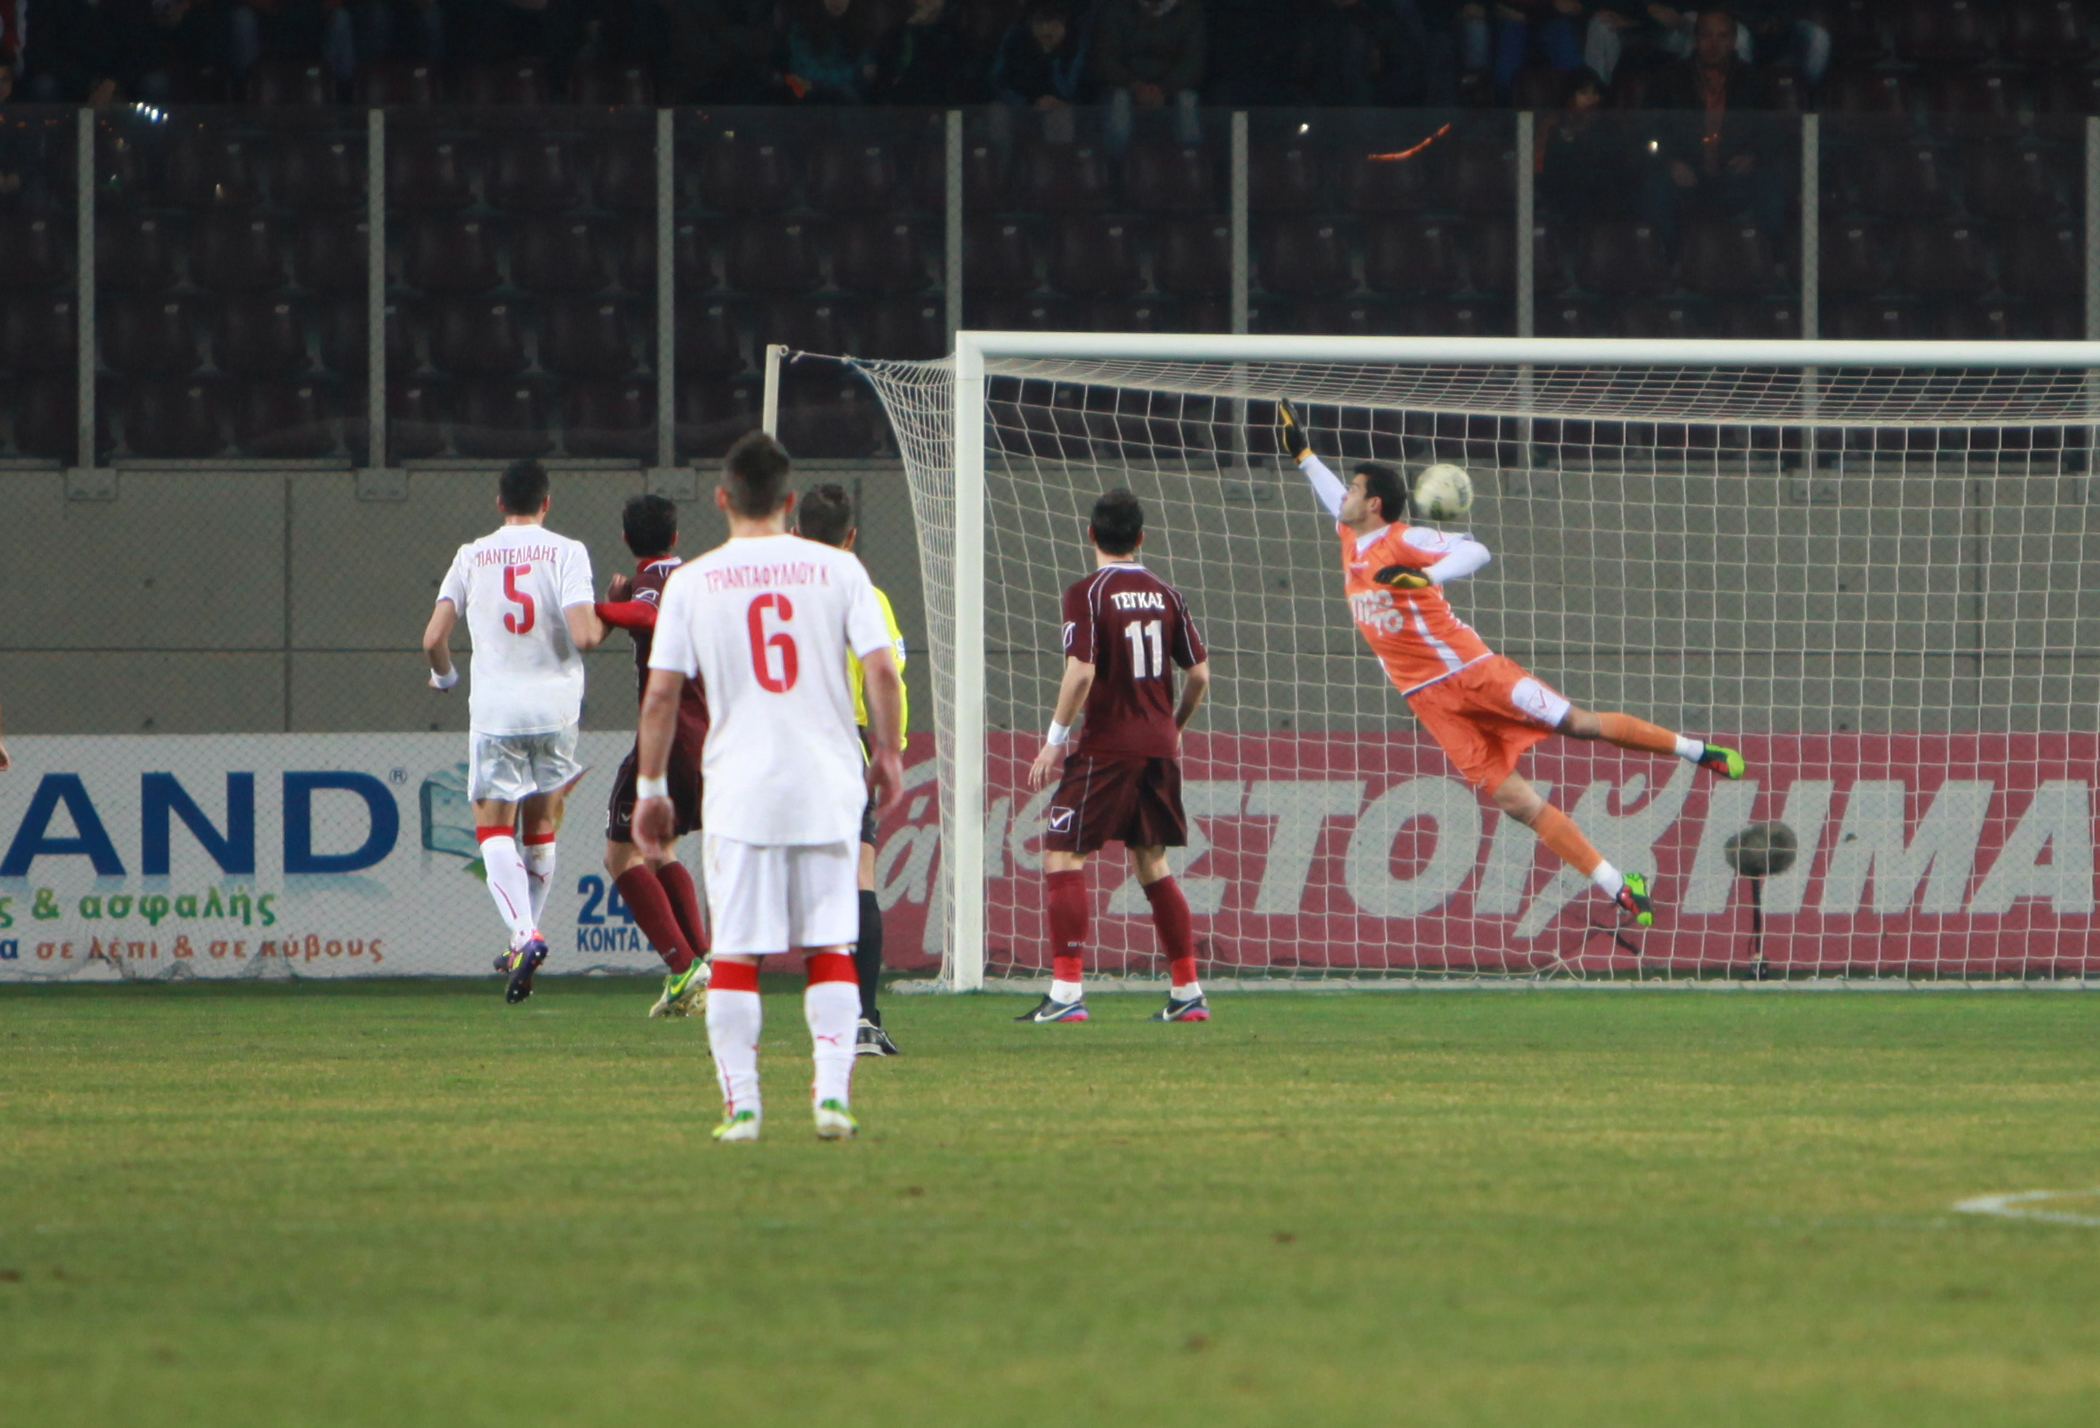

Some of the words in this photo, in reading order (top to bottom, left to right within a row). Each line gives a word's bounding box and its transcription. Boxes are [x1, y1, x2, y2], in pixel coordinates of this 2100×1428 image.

[503, 564, 535, 634] 5
[747, 593, 798, 693] 6
[1124, 620, 1162, 678] 11
[79, 885, 276, 927] ασφαλής
[36, 941, 74, 959] σε
[88, 935, 158, 959] λέπι
[209, 940, 248, 959] σε
[259, 932, 383, 964] κύβους
